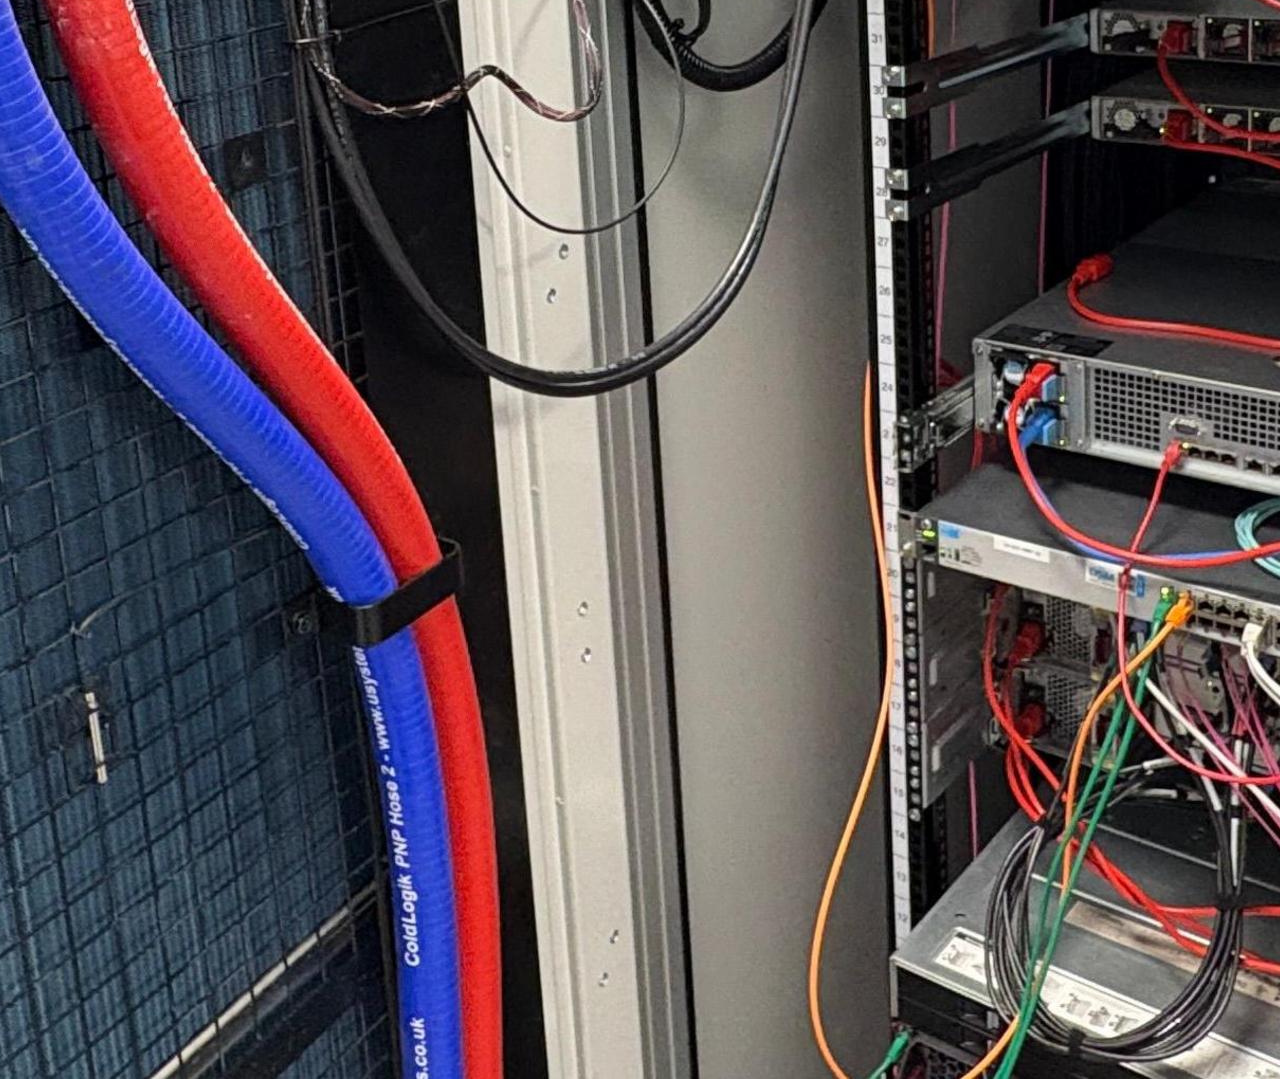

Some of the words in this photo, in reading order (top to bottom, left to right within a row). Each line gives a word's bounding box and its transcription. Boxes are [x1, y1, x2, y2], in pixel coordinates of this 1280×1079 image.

[871, 33, 883, 44] 31
[380, 764, 397, 778] 2
[386, 780, 405, 826] Hose
[391, 829, 411, 868] PNP
[397, 874, 421, 968] ColdLogik
